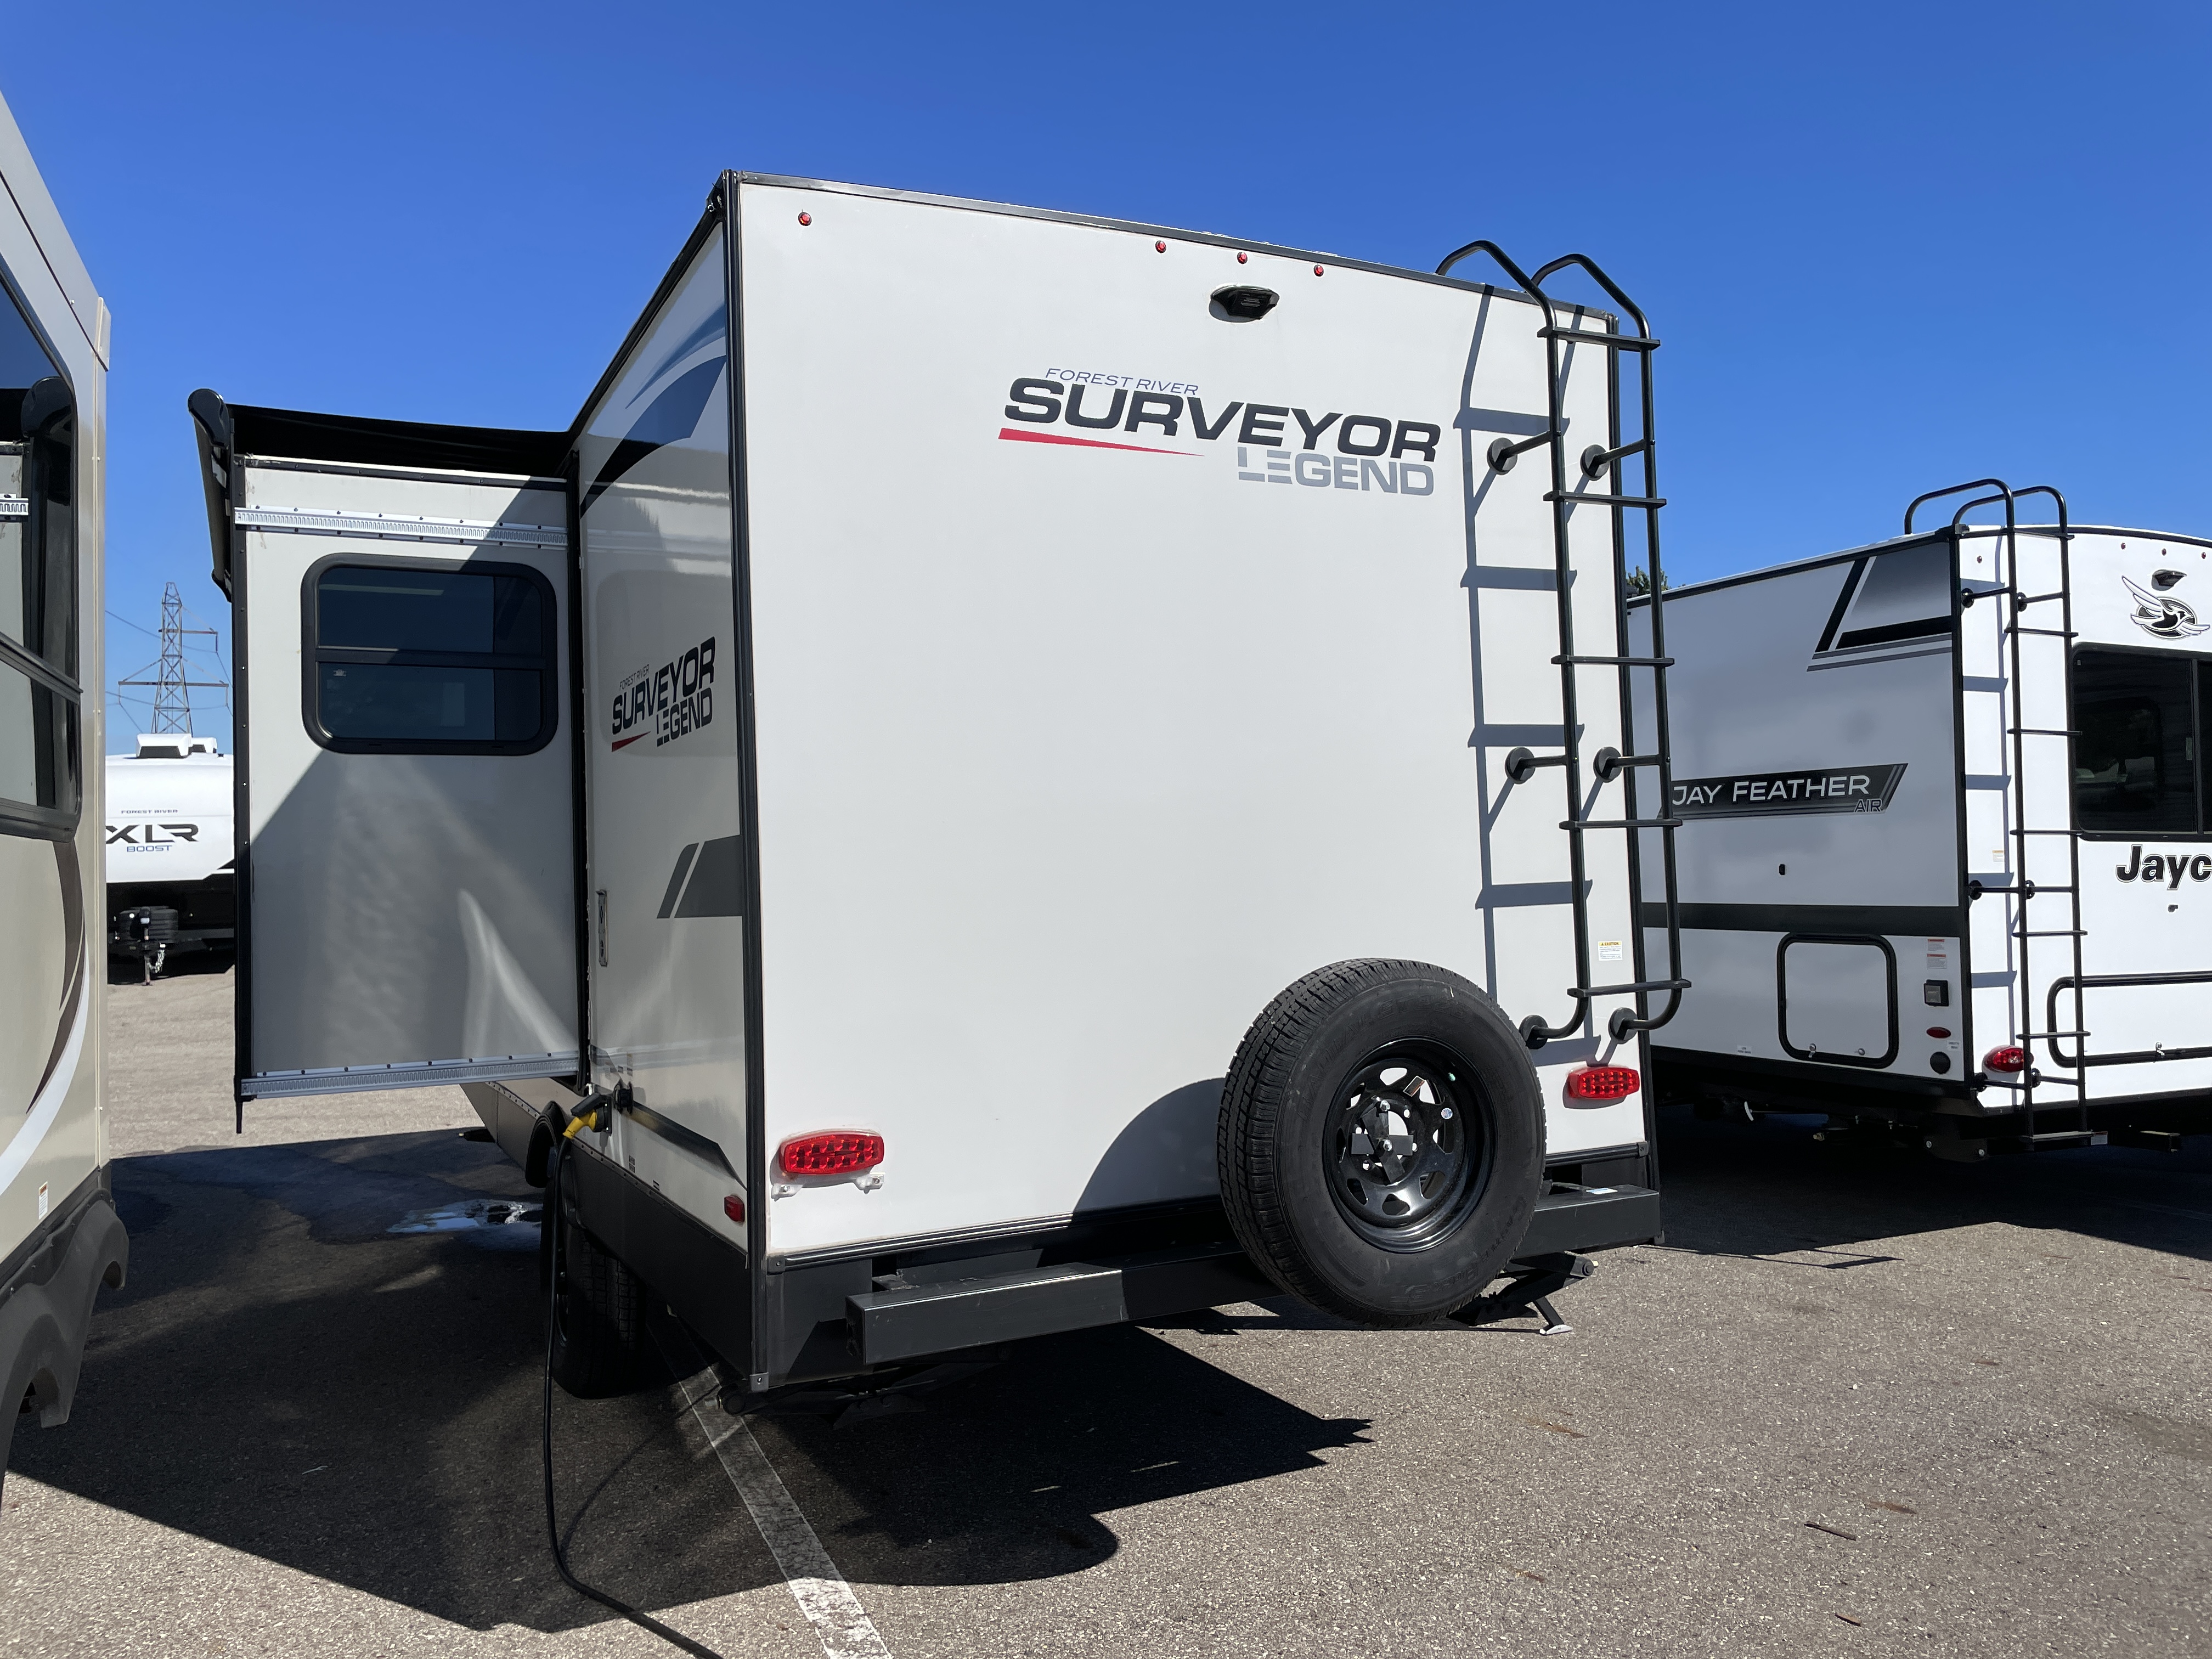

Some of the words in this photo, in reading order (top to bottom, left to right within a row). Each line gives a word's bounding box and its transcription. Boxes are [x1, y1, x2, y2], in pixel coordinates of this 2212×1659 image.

[1046, 368, 1133, 387] FOREST
[1136, 379, 1199, 395] RIVER
[1005, 376, 1441, 462] SURVEYOR
[1237, 446, 1435, 496] LEGEND
[612, 636, 715, 735] SURVEYOR
[619, 673, 636, 691] FOREST
[657, 687, 713, 747] LEGEND
[1672, 785, 1723, 805] JAY
[1733, 775, 1870, 803] FEATHER
[1854, 798, 1883, 813] AIR
[105, 823, 199, 844] XLR
[2115, 844, 2212, 890] Jayc
